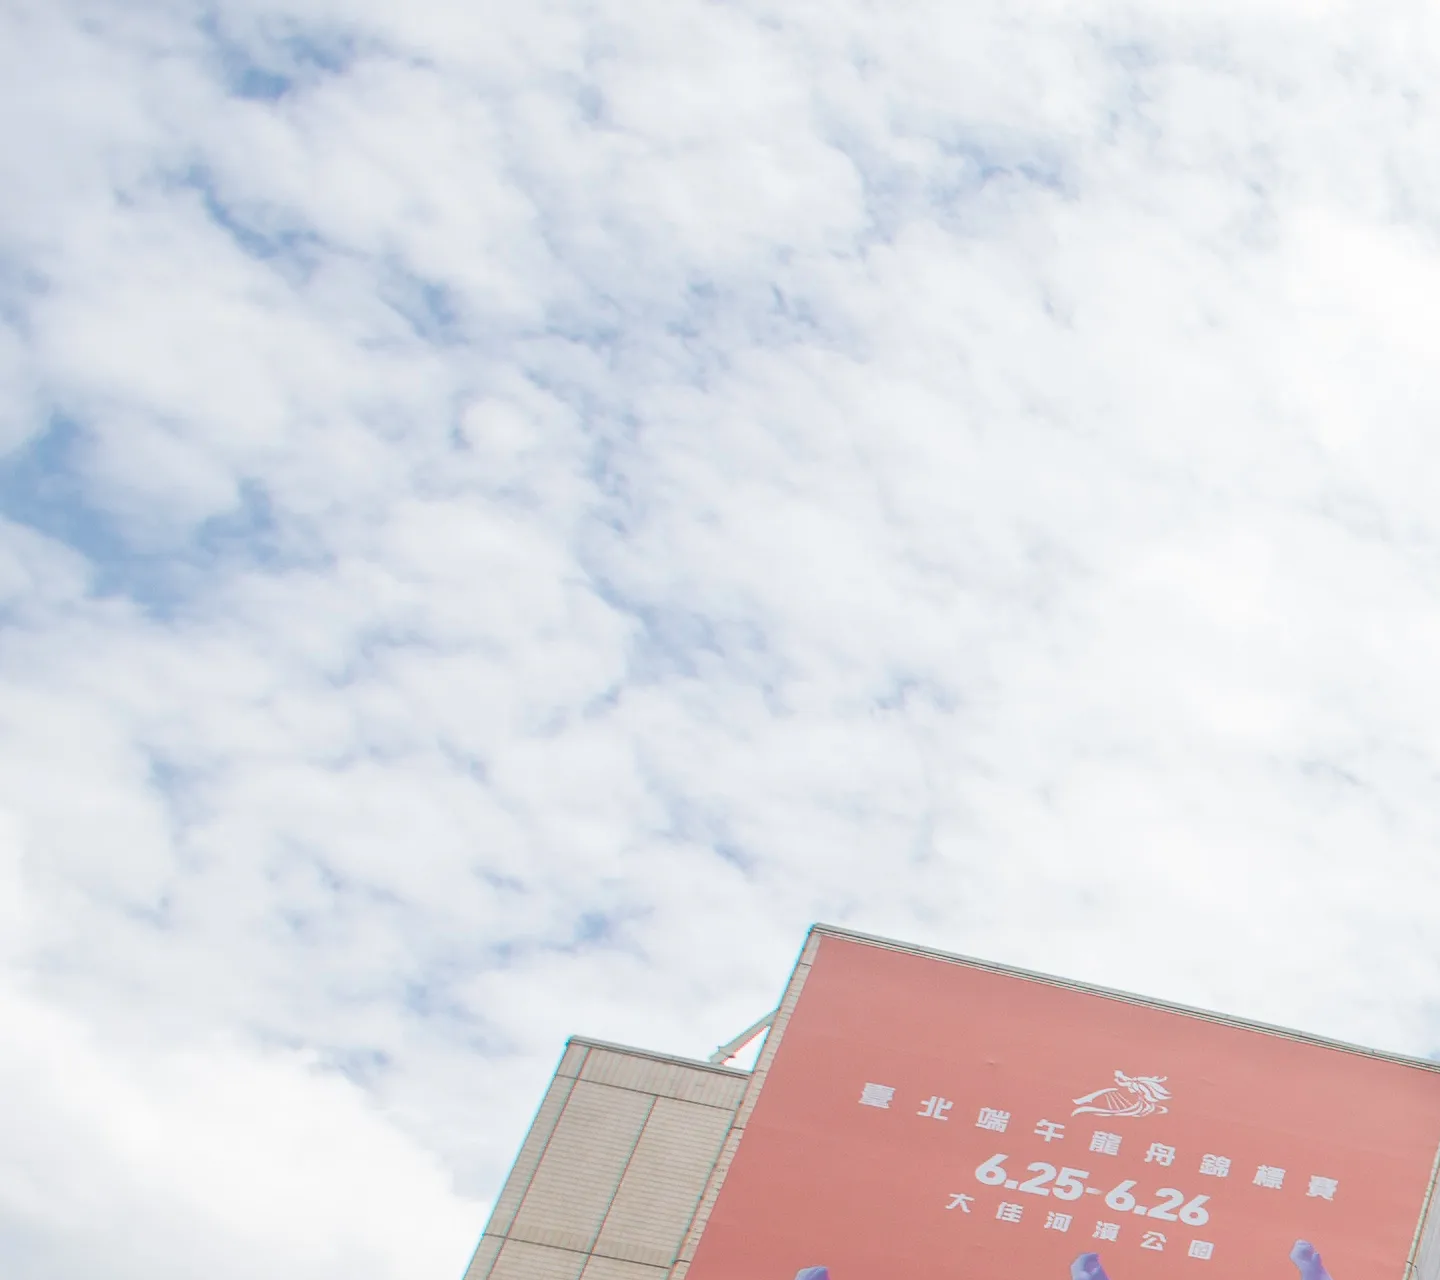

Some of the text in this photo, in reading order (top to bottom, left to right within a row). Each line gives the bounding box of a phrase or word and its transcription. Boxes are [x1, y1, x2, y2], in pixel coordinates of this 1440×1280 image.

[858, 1082, 1339, 1201] 臺北端午龍舟錦標賽
[945, 1192, 1215, 1261] 大佳河濱公園
[974, 1153, 1210, 1227] 6.25-6.26
